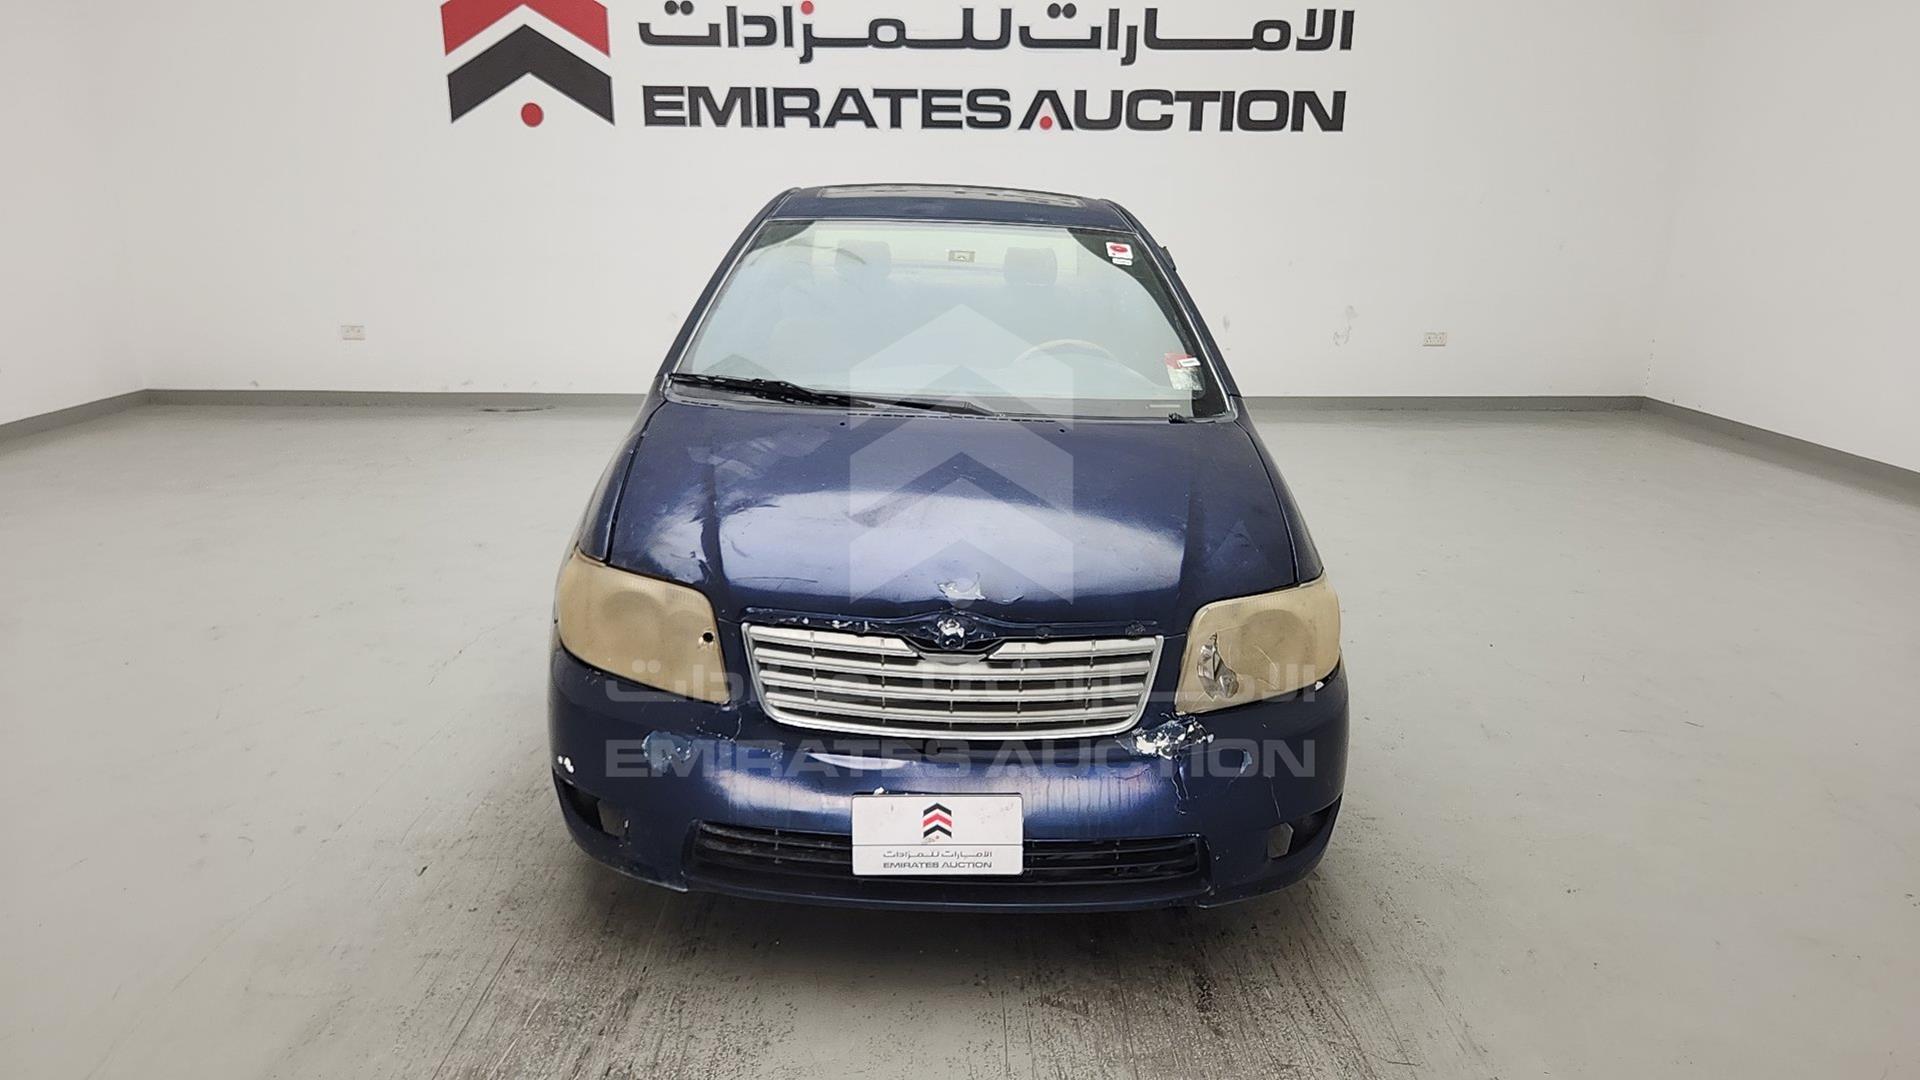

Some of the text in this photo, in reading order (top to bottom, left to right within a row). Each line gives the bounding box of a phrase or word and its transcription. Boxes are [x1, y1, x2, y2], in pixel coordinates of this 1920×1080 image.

[638, 0, 1355, 66] الامارات للمزادات
[642, 85, 1347, 132] EMIRATES AUCTION
[883, 861, 993, 869] EMIRATES AUCTION
